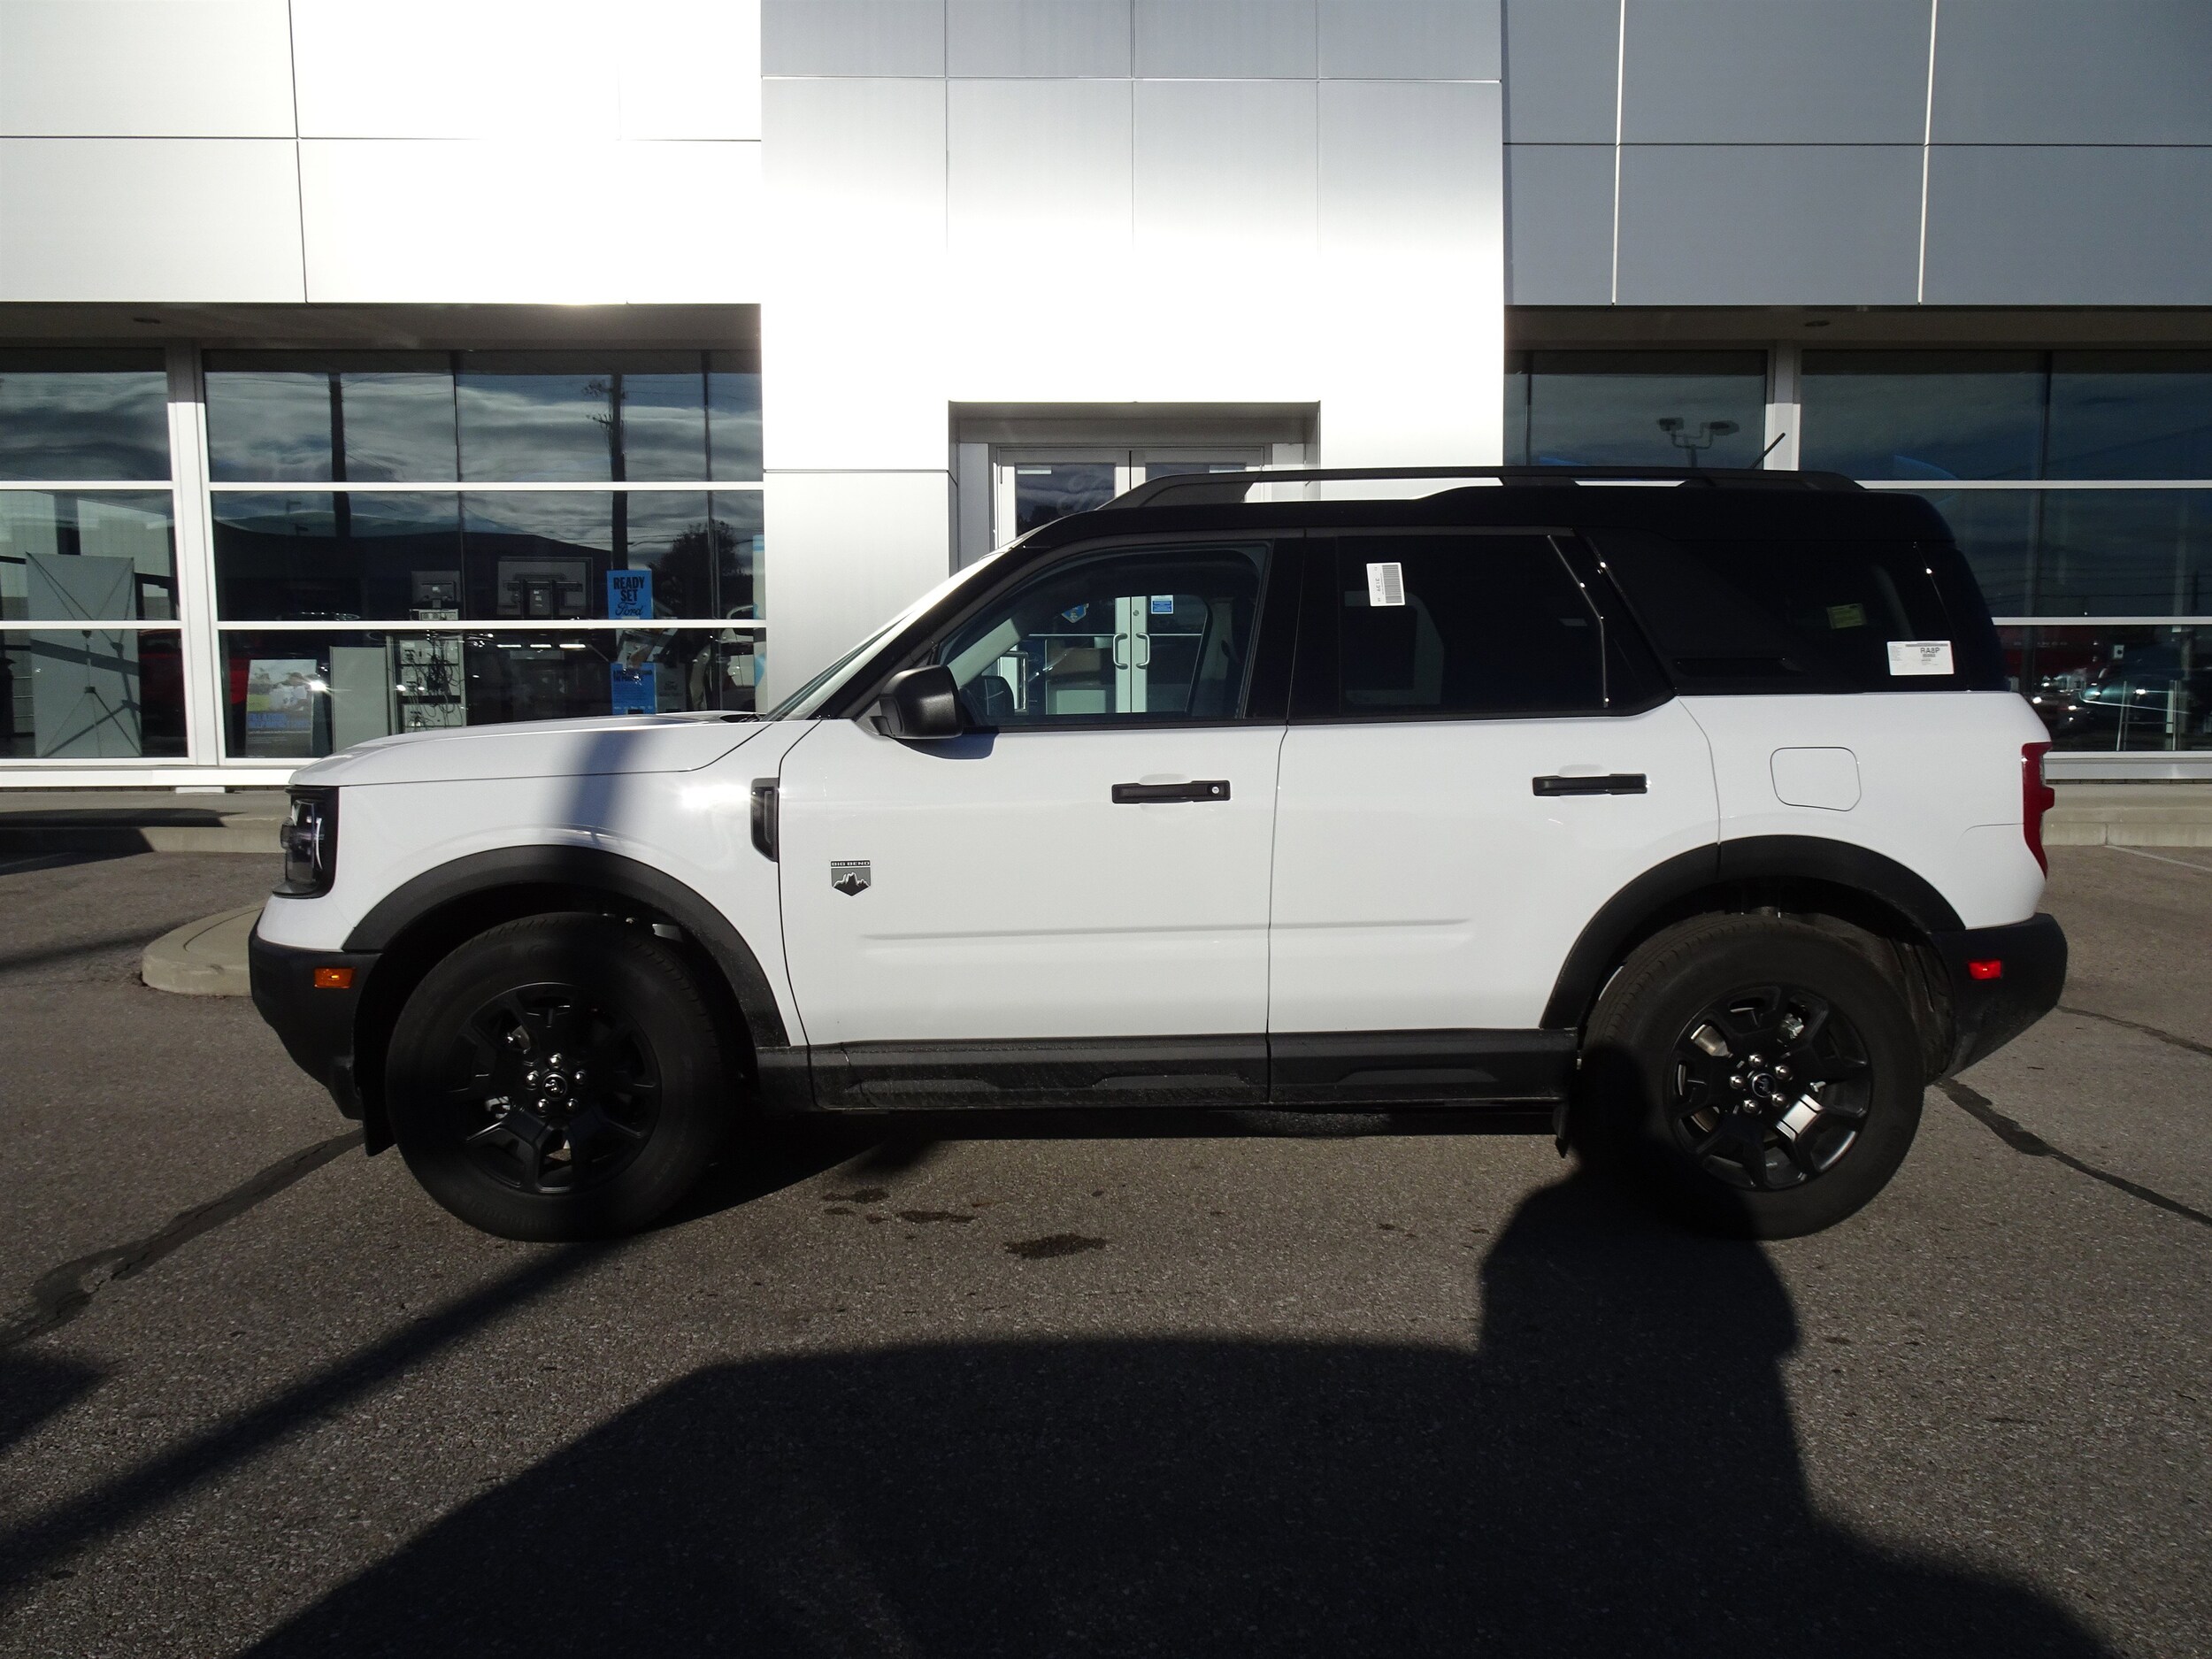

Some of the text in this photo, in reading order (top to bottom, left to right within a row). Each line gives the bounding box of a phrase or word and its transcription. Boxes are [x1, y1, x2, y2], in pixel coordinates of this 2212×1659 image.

[613, 576, 644, 589] READY
[621, 588, 638, 603] SET
[615, 603, 643, 617] Ford
